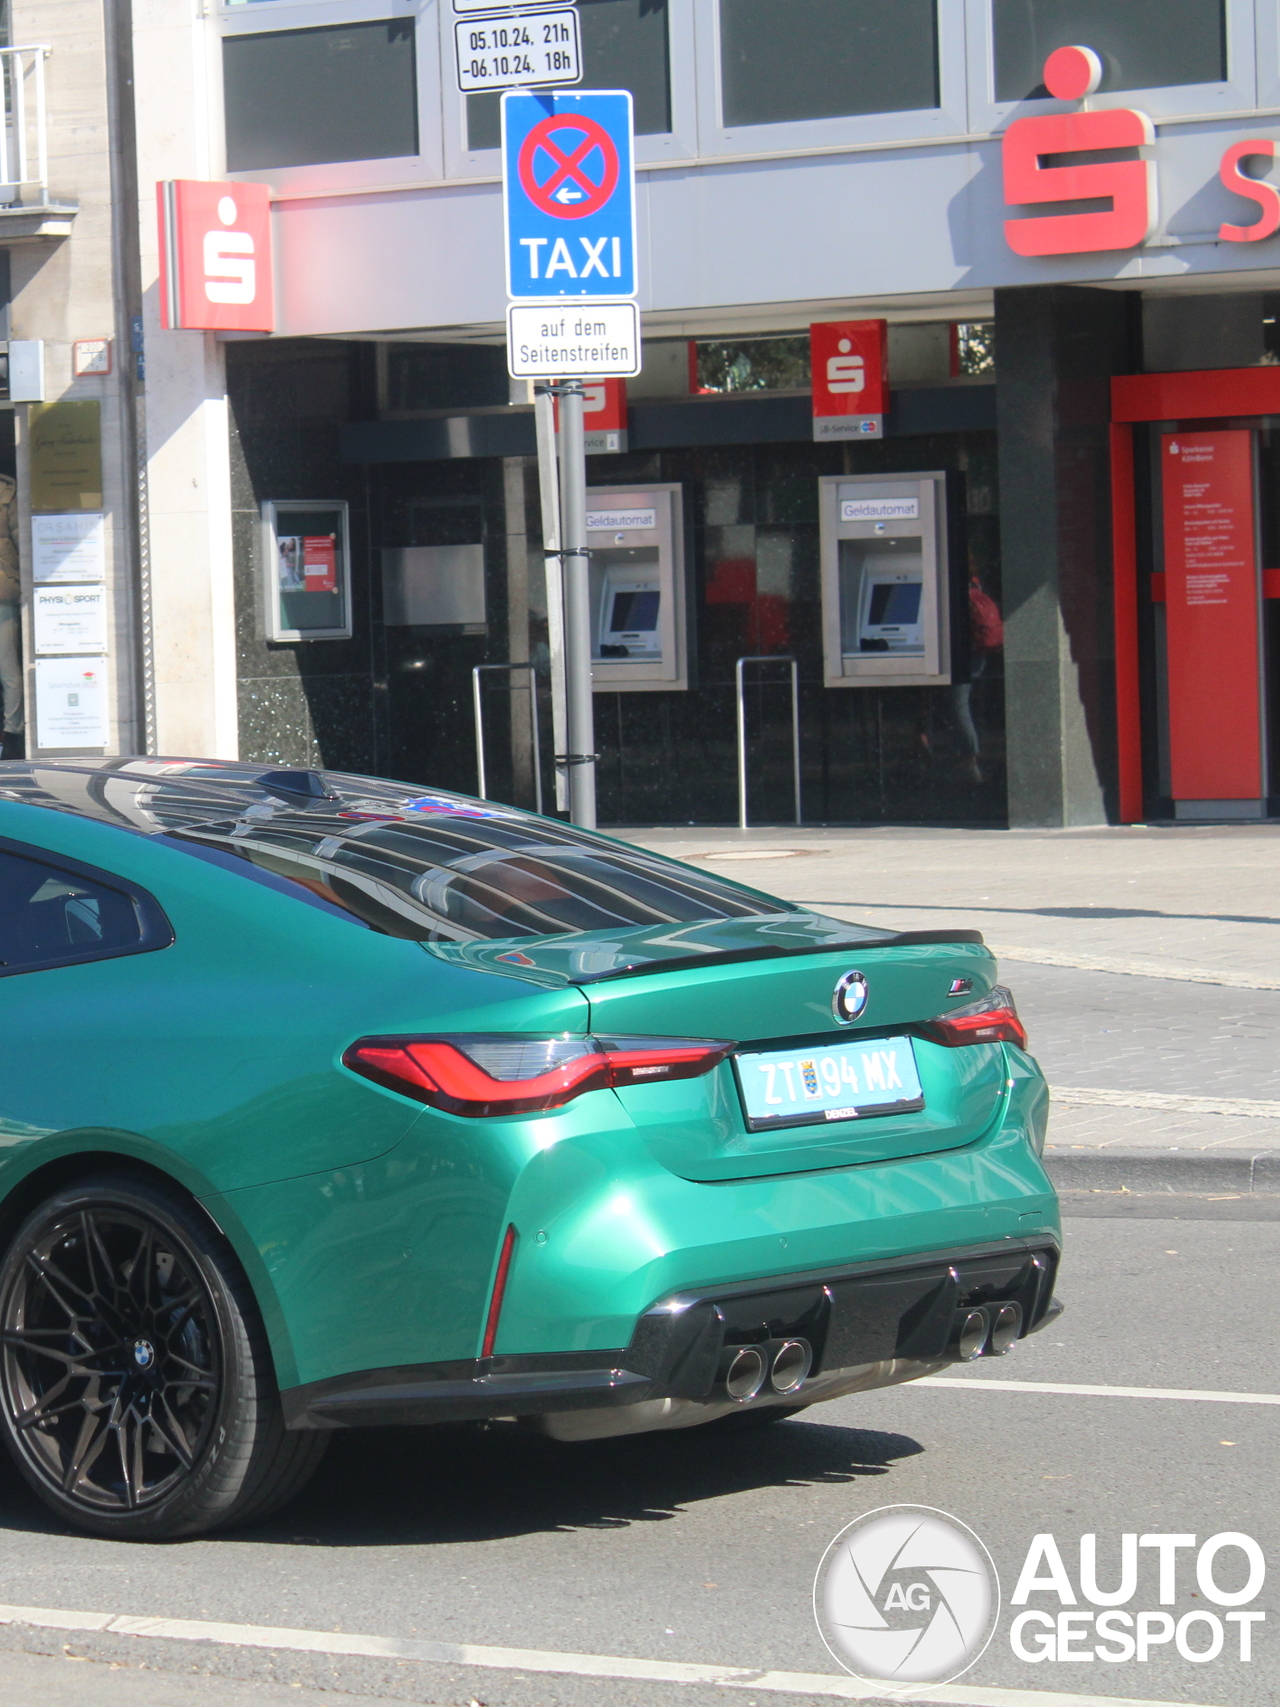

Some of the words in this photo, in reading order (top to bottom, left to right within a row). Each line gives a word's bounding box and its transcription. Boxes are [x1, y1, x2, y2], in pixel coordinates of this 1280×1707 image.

[470, 27, 534, 50] 05.10.24,
[543, 23, 569, 43] 21h
[545, 51, 570, 71] 18h
[520, 237, 621, 278] TAXI
[541, 320, 566, 337] auf
[574, 319, 606, 336] dem
[520, 344, 628, 364] Seitenstreifen
[586, 514, 654, 528] Geldautomat
[844, 504, 916, 518] Geldautomat
[758, 1061, 797, 1105] ZT
[819, 1056, 859, 1097] 94
[860, 1050, 903, 1092] MX
[824, 1107, 859, 1120] DENZEL
